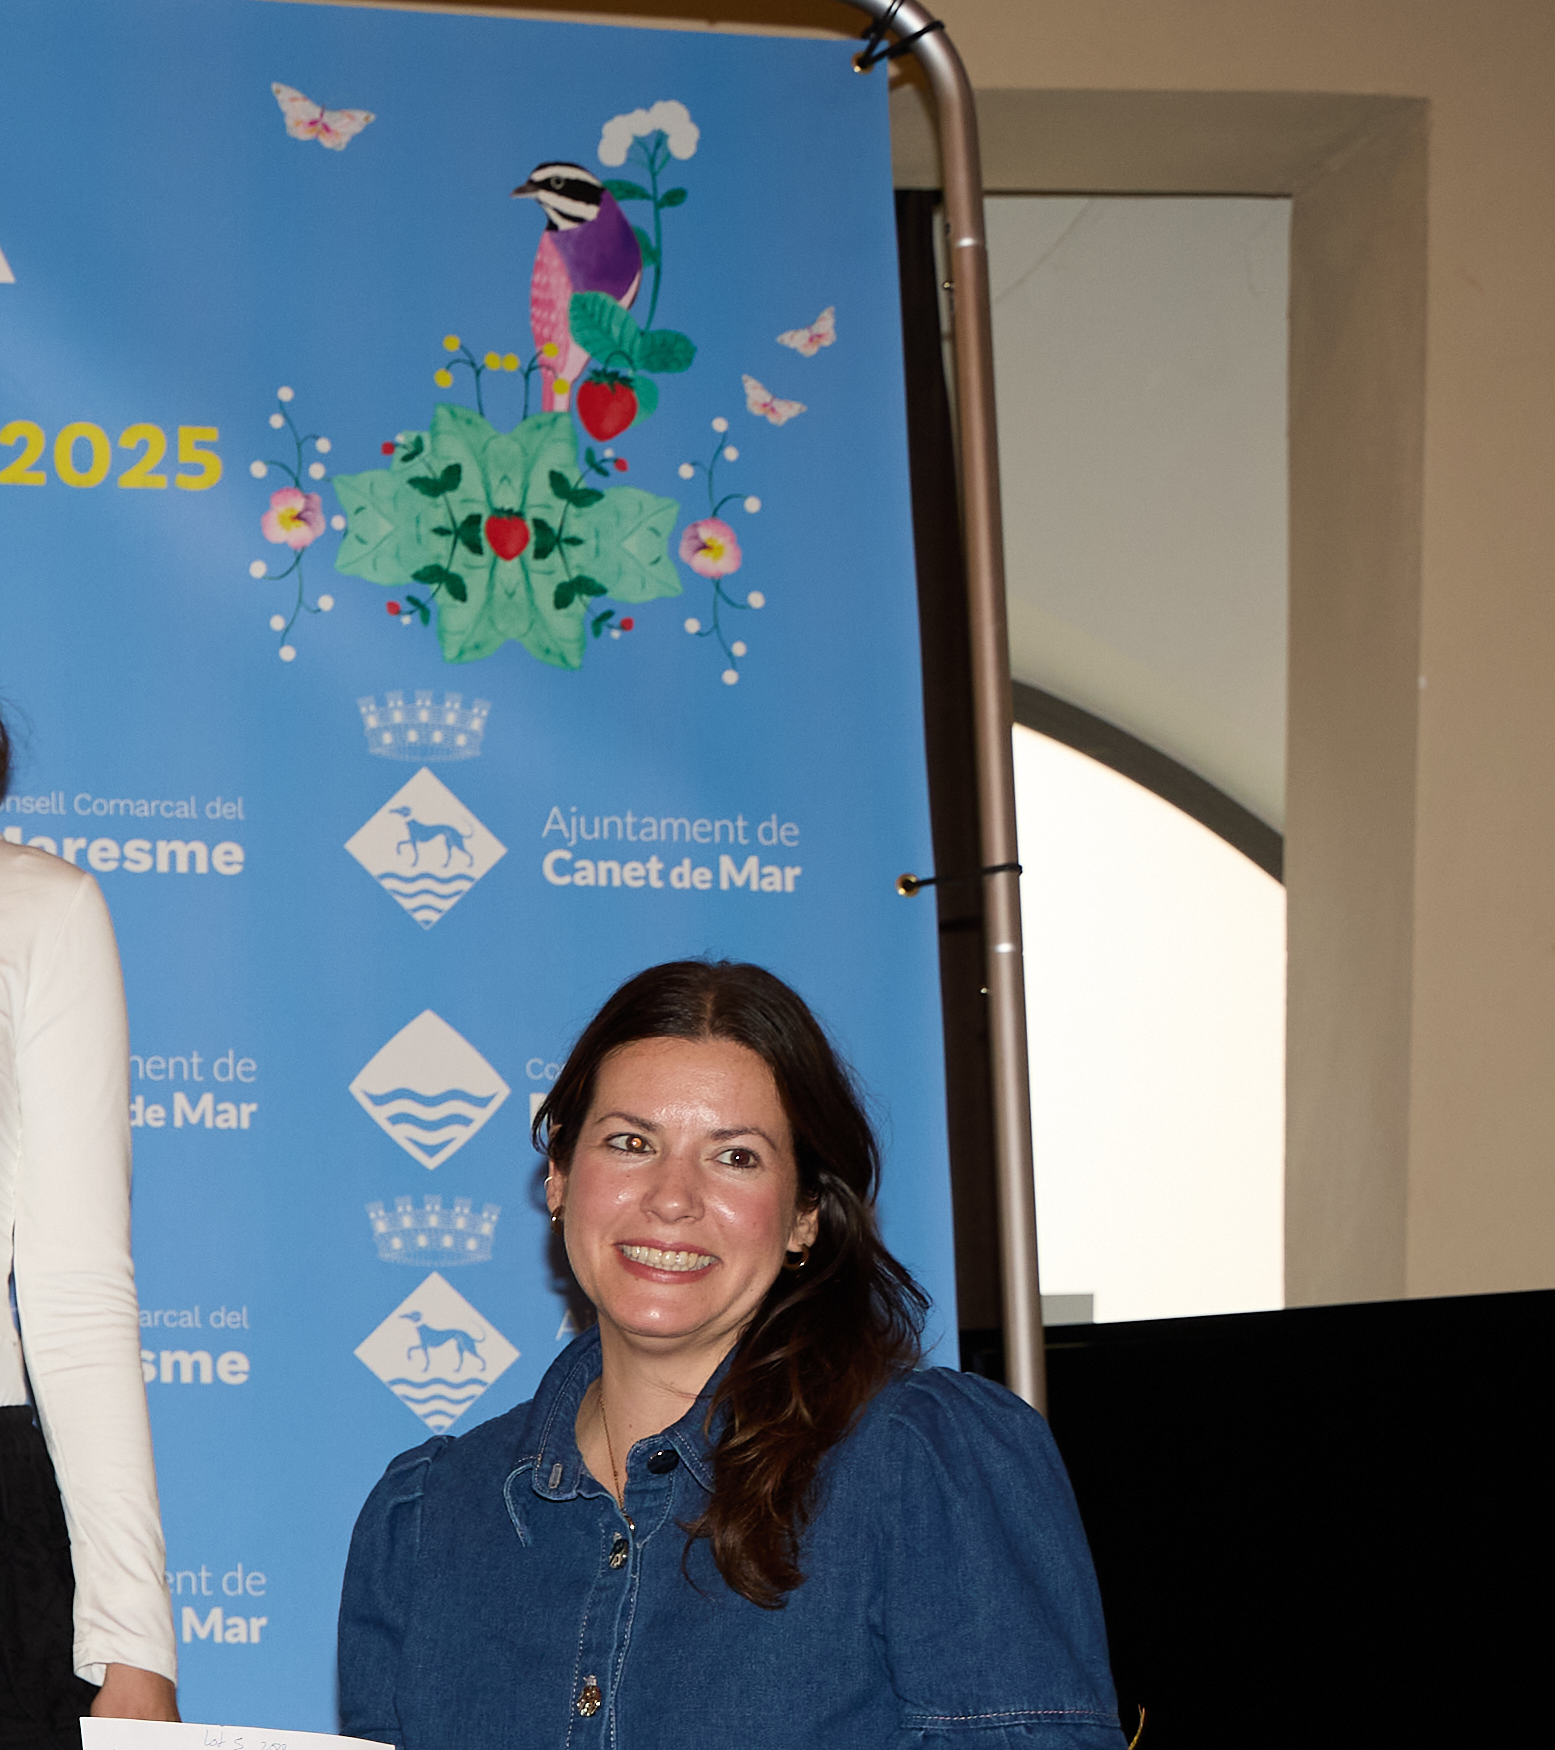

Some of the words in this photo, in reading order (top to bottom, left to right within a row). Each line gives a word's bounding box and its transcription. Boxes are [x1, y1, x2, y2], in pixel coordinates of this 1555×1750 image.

[73, 792, 198, 820] Comarcal
[204, 795, 246, 821] del
[541, 805, 737, 846] Ajuntament
[750, 812, 801, 846] de
[542, 848, 665, 892] Canet
[670, 855, 715, 892] de
[720, 853, 802, 894] Mar
[212, 1048, 258, 1083] de
[173, 1090, 259, 1130] Mar
[139, 1305, 203, 1329] arcal
[209, 1305, 250, 1330] del
[222, 1562, 268, 1597] de
[182, 1606, 268, 1644] Mar
